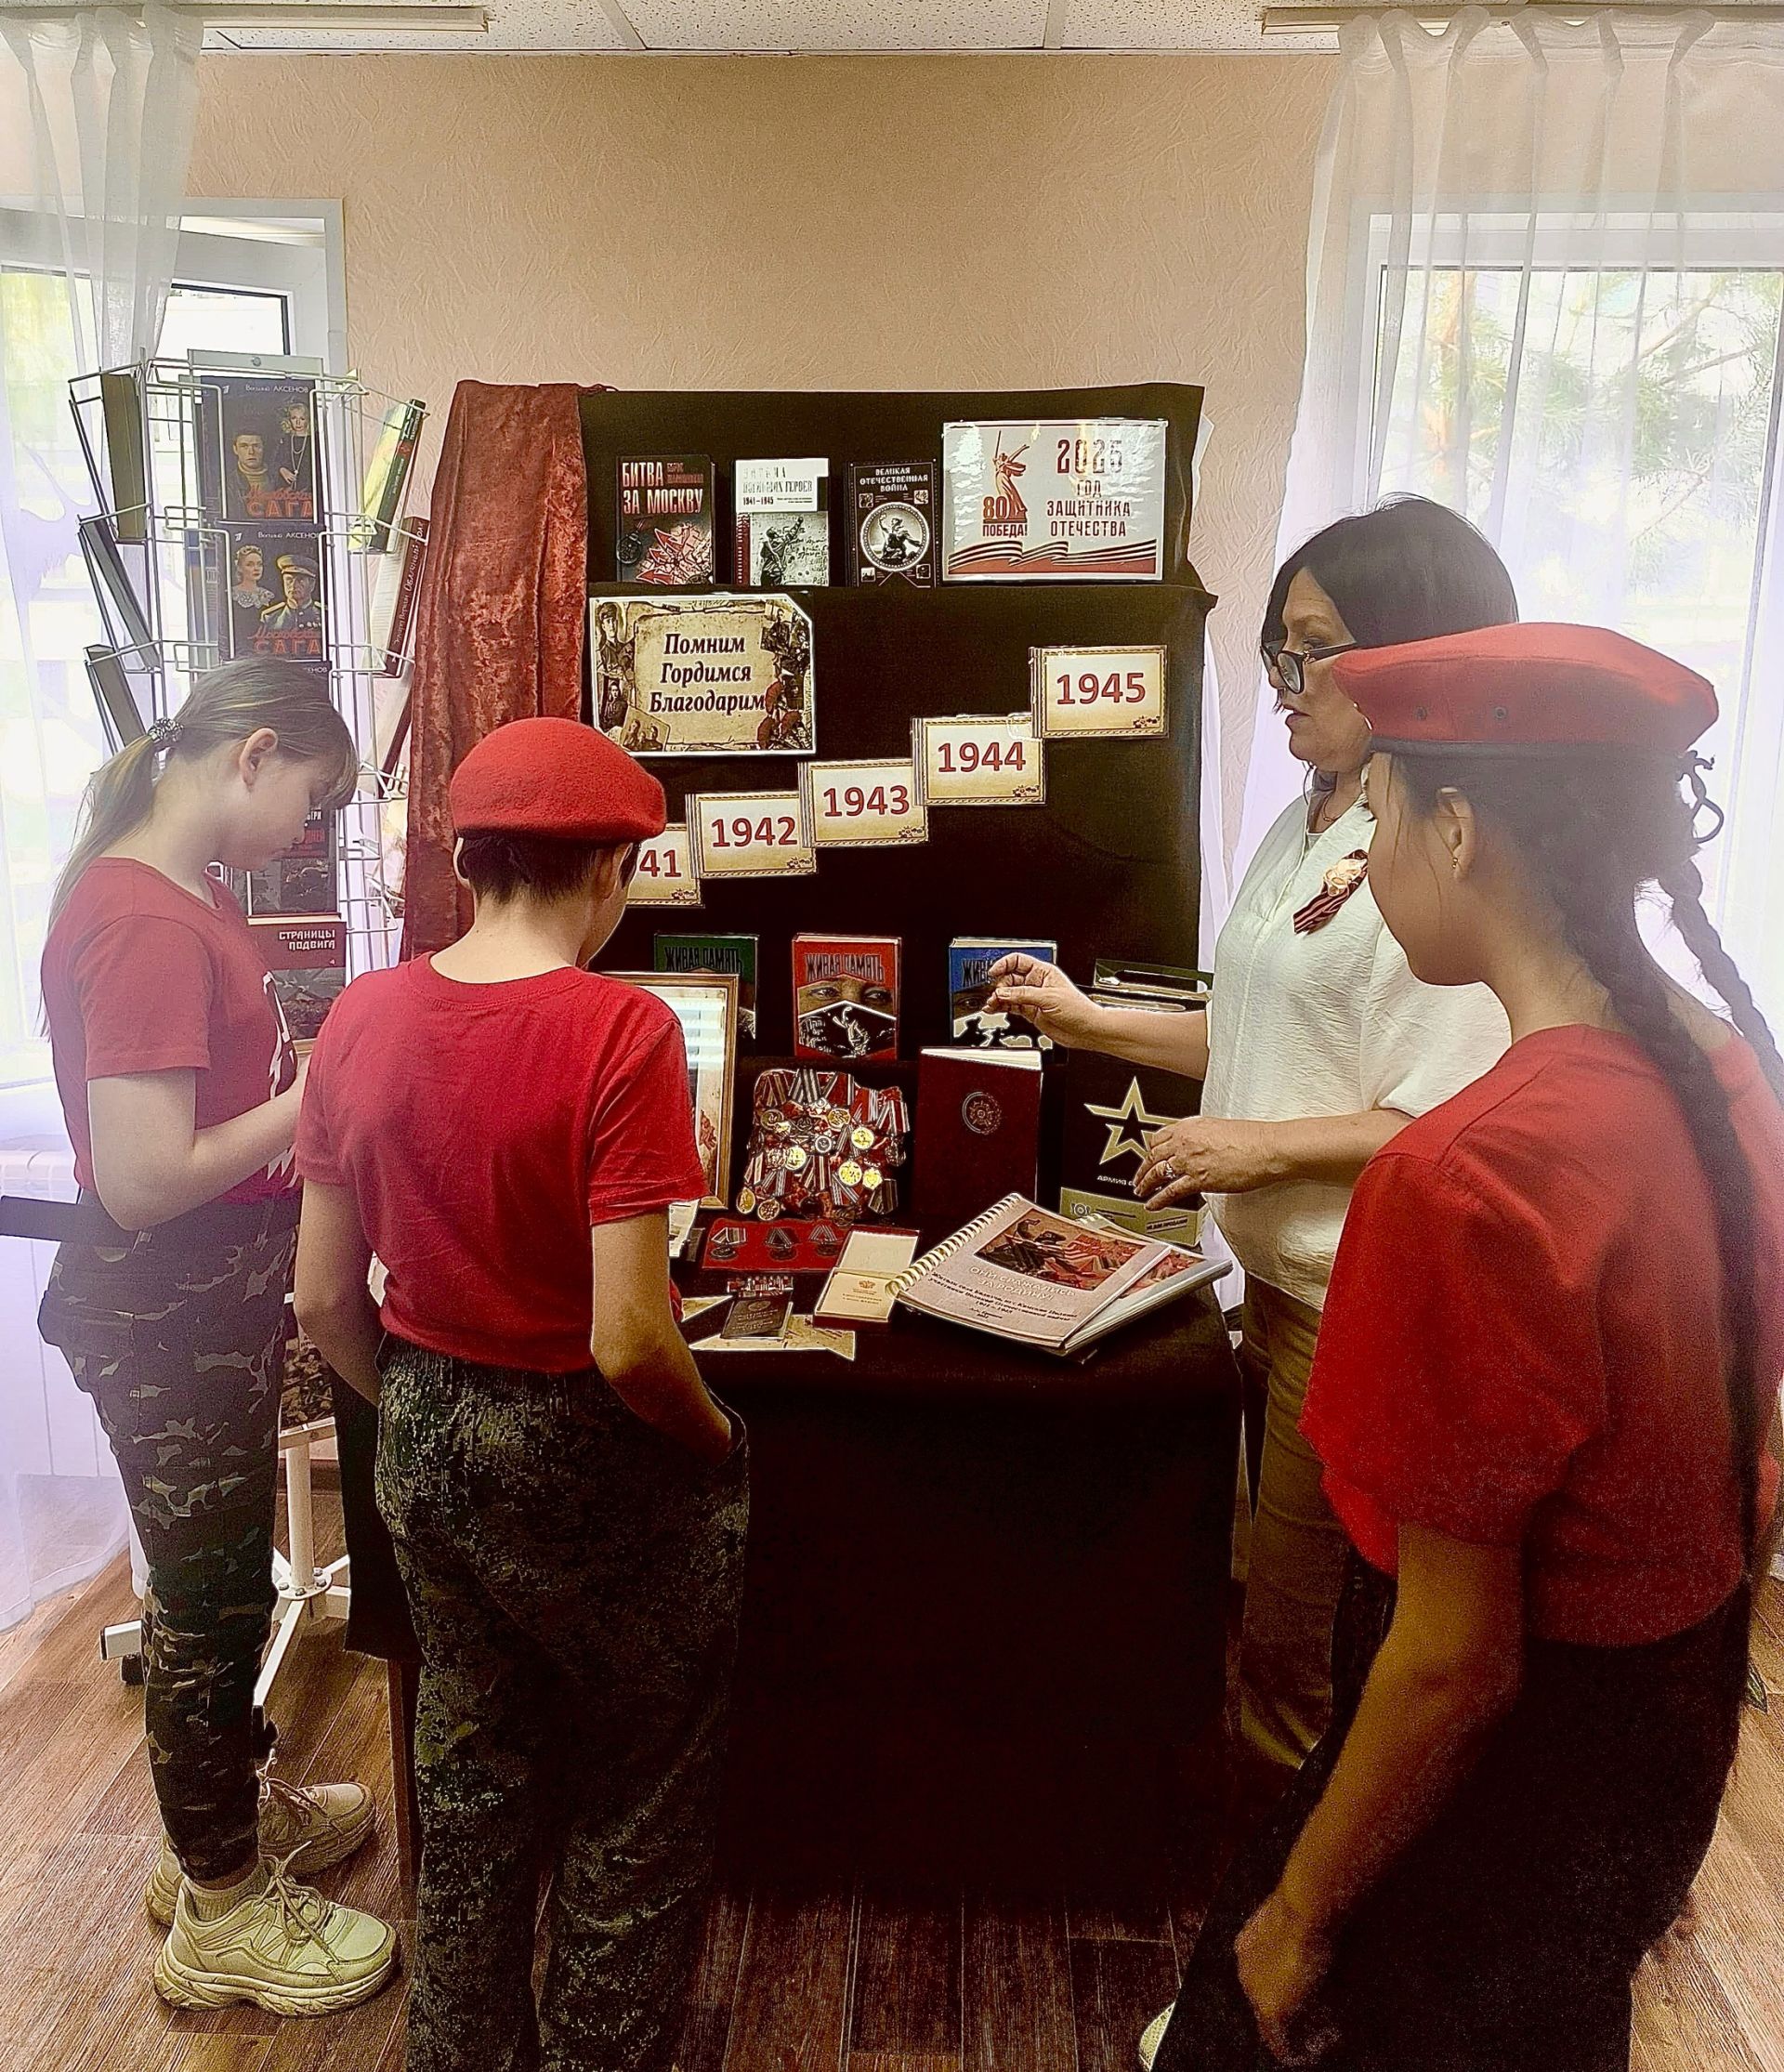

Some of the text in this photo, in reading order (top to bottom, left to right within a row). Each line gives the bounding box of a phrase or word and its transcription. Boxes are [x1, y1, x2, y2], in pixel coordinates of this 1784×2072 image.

[1056, 439, 1122, 475] 2025
[622, 462, 664, 488] БИТВА
[859, 474, 928, 485] ОТЕЧЕСТВЕННАЯ
[875, 466, 911, 476] ВЕЛИКАЯ
[785, 479, 813, 493] ГЕРОЕВ
[880, 484, 908, 492] ВОЙНА
[1077, 479, 1102, 498] ГОД
[246, 501, 313, 518] САГА
[623, 488, 703, 515] ЗА МОСКВУ
[983, 496, 1008, 519] 80
[1047, 500, 1131, 518] ЗАЩИТНИКА
[982, 523, 1028, 539] ПОБЕДА!
[1050, 520, 1126, 537] ОТЕЧЕСТВА
[254, 638, 322, 655] САГА
[663, 633, 745, 655] Помним
[660, 661, 752, 688] Гордимся
[650, 685, 766, 715] Благодарим
[1056, 672, 1147, 705] 1945
[938, 741, 1027, 773] 1944
[823, 785, 910, 818] 1943
[711, 816, 798, 848] 1942
[638, 849, 682, 878] 41
[279, 929, 335, 941] СТРАНИЦЫ
[288, 939, 335, 951] ПОДВИГА
[664, 946, 742, 972] ЖИВАЯ ПАМЯТЬ
[805, 953, 885, 982] ЖИВАЯ ПАМЯТЬ
[960, 957, 993, 989] ЖИВ
[1096, 1174, 1127, 1186] АРМИЯ
[970, 1266, 997, 1279] ОНИ
[999, 1275, 1076, 1297] СРАЖАЛИСЬ
[979, 1279, 994, 1289] ЗА
[996, 1282, 1055, 1302] РОДИНУ!
